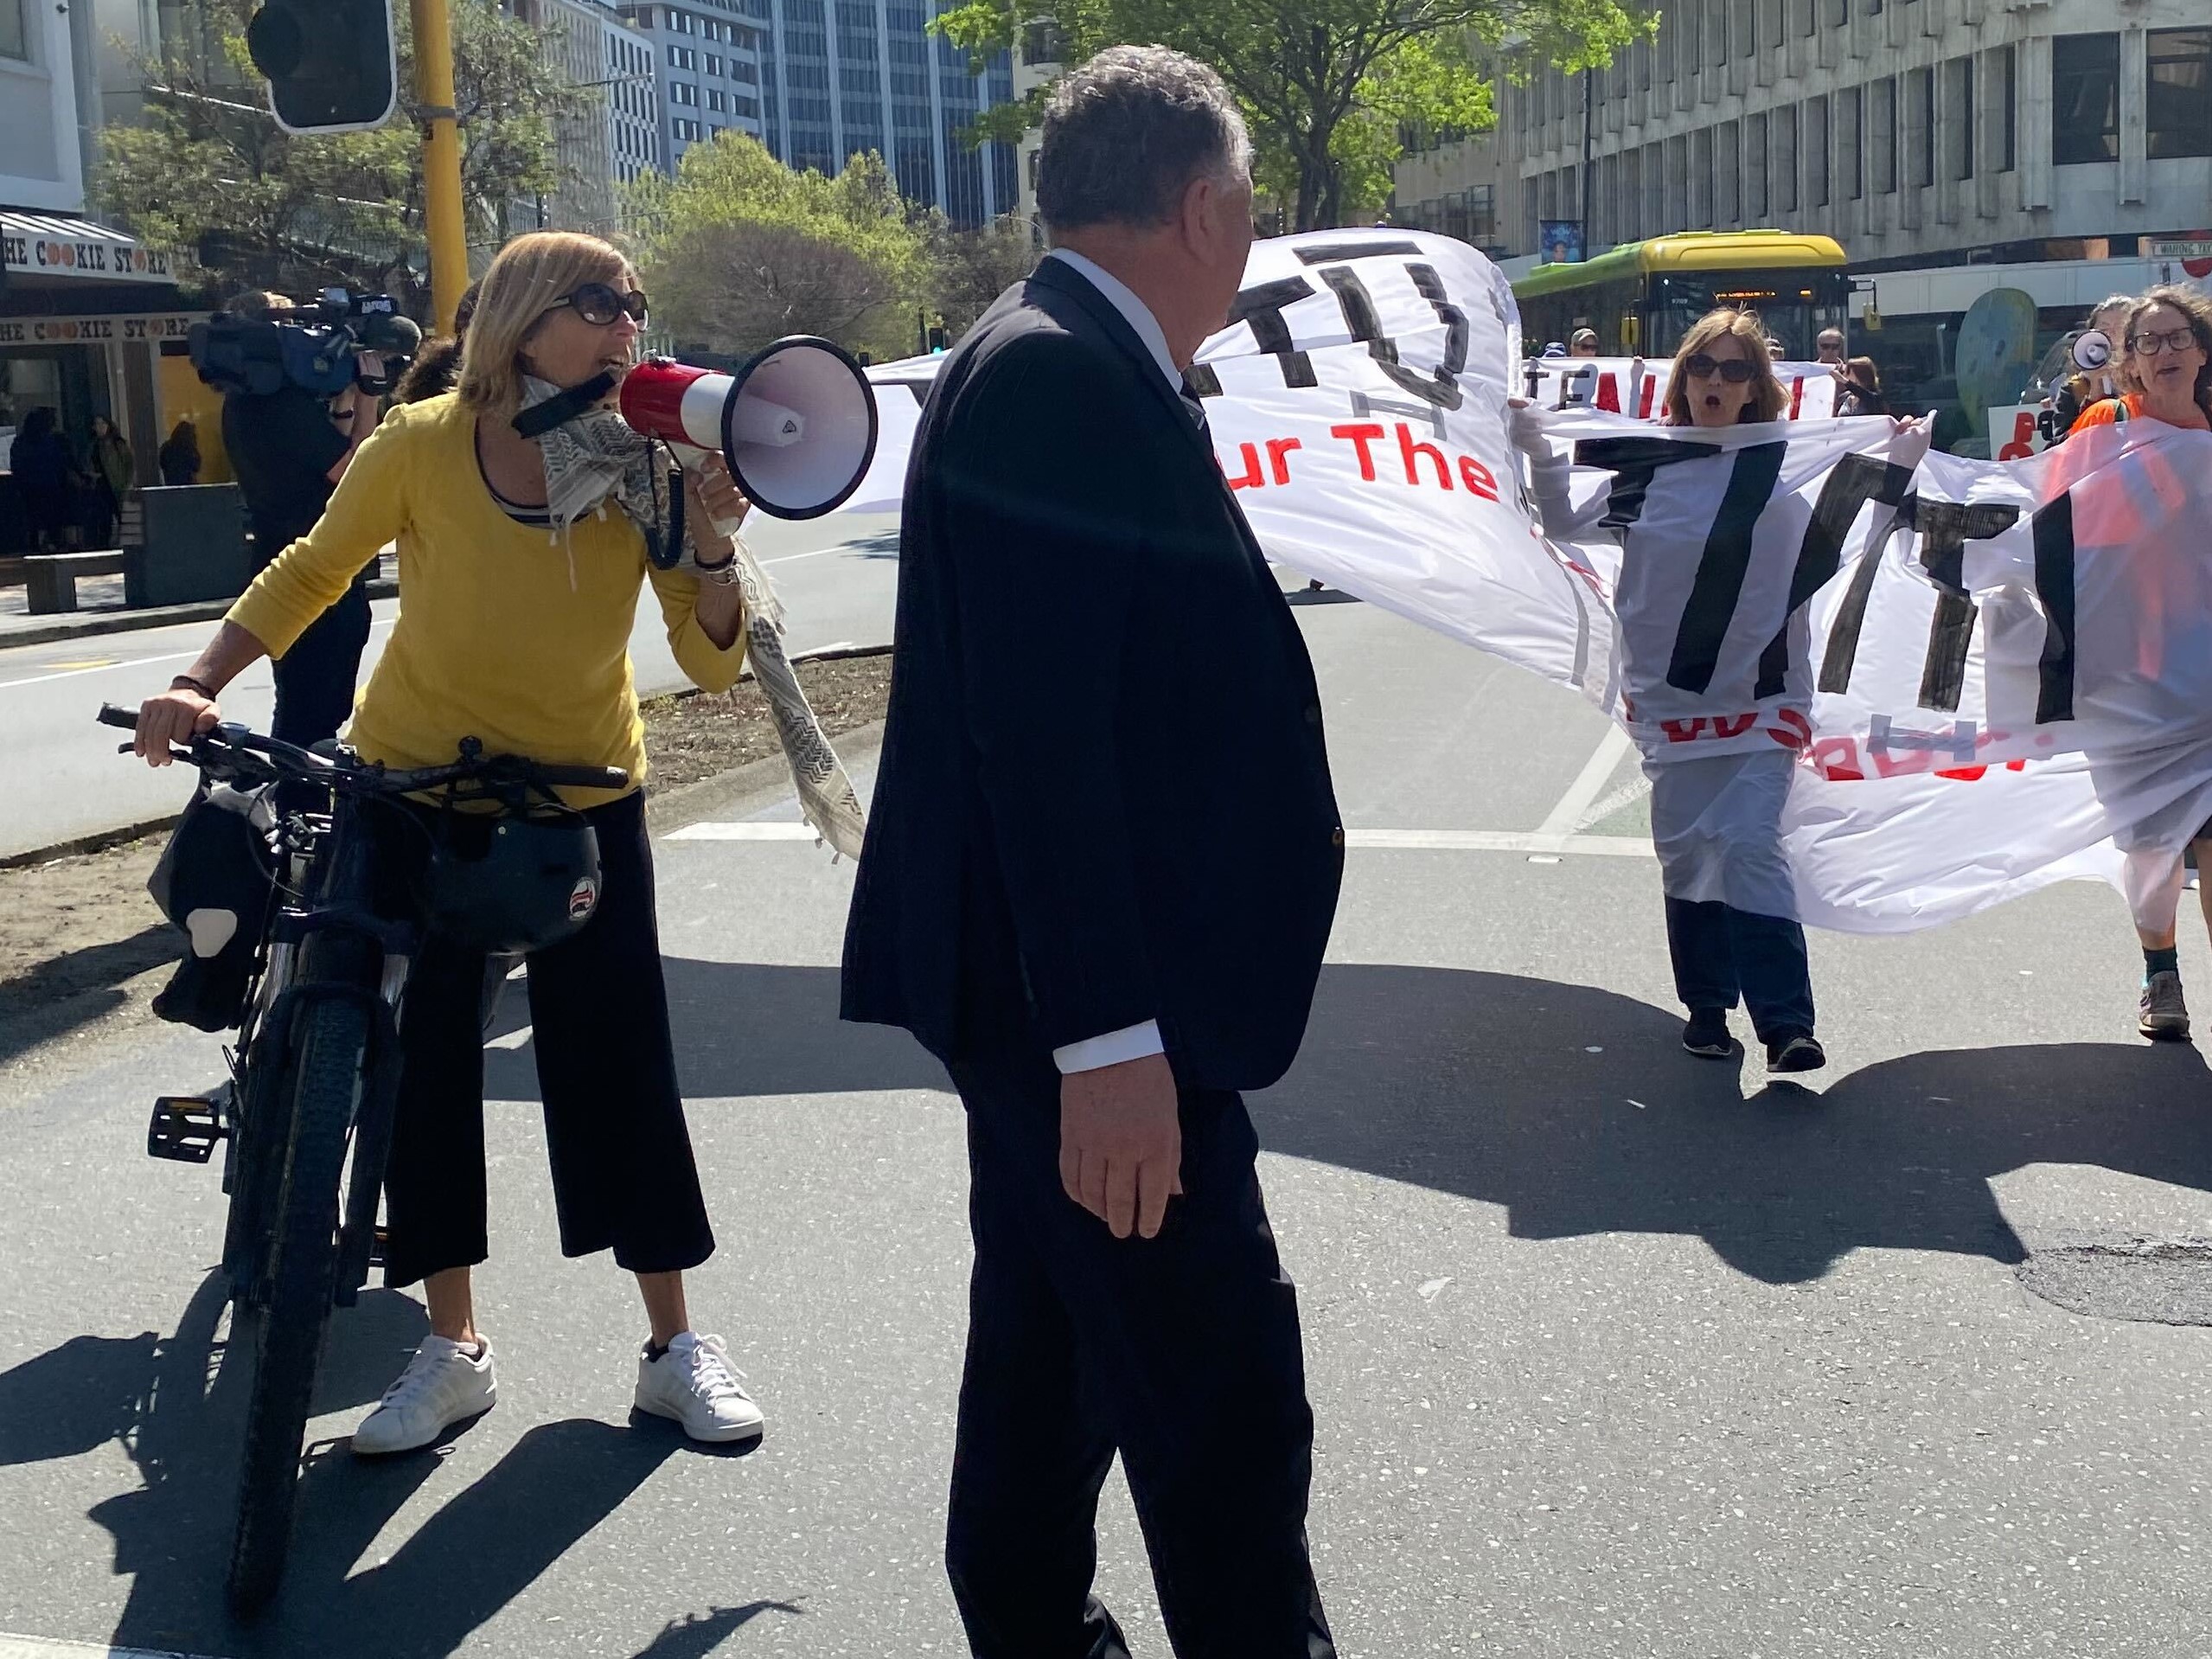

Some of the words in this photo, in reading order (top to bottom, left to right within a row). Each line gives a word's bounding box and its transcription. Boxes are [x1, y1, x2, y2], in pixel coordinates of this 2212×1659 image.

[3, 238, 28, 265] HE
[36, 240, 105, 272] COOKIE
[114, 247, 167, 275] STORE
[0, 323, 24, 342] HE
[35, 319, 112, 340] COOKIE
[124, 317, 189, 338] STORE
[1216, 437, 1302, 490] ur
[1331, 422, 1500, 503] The
